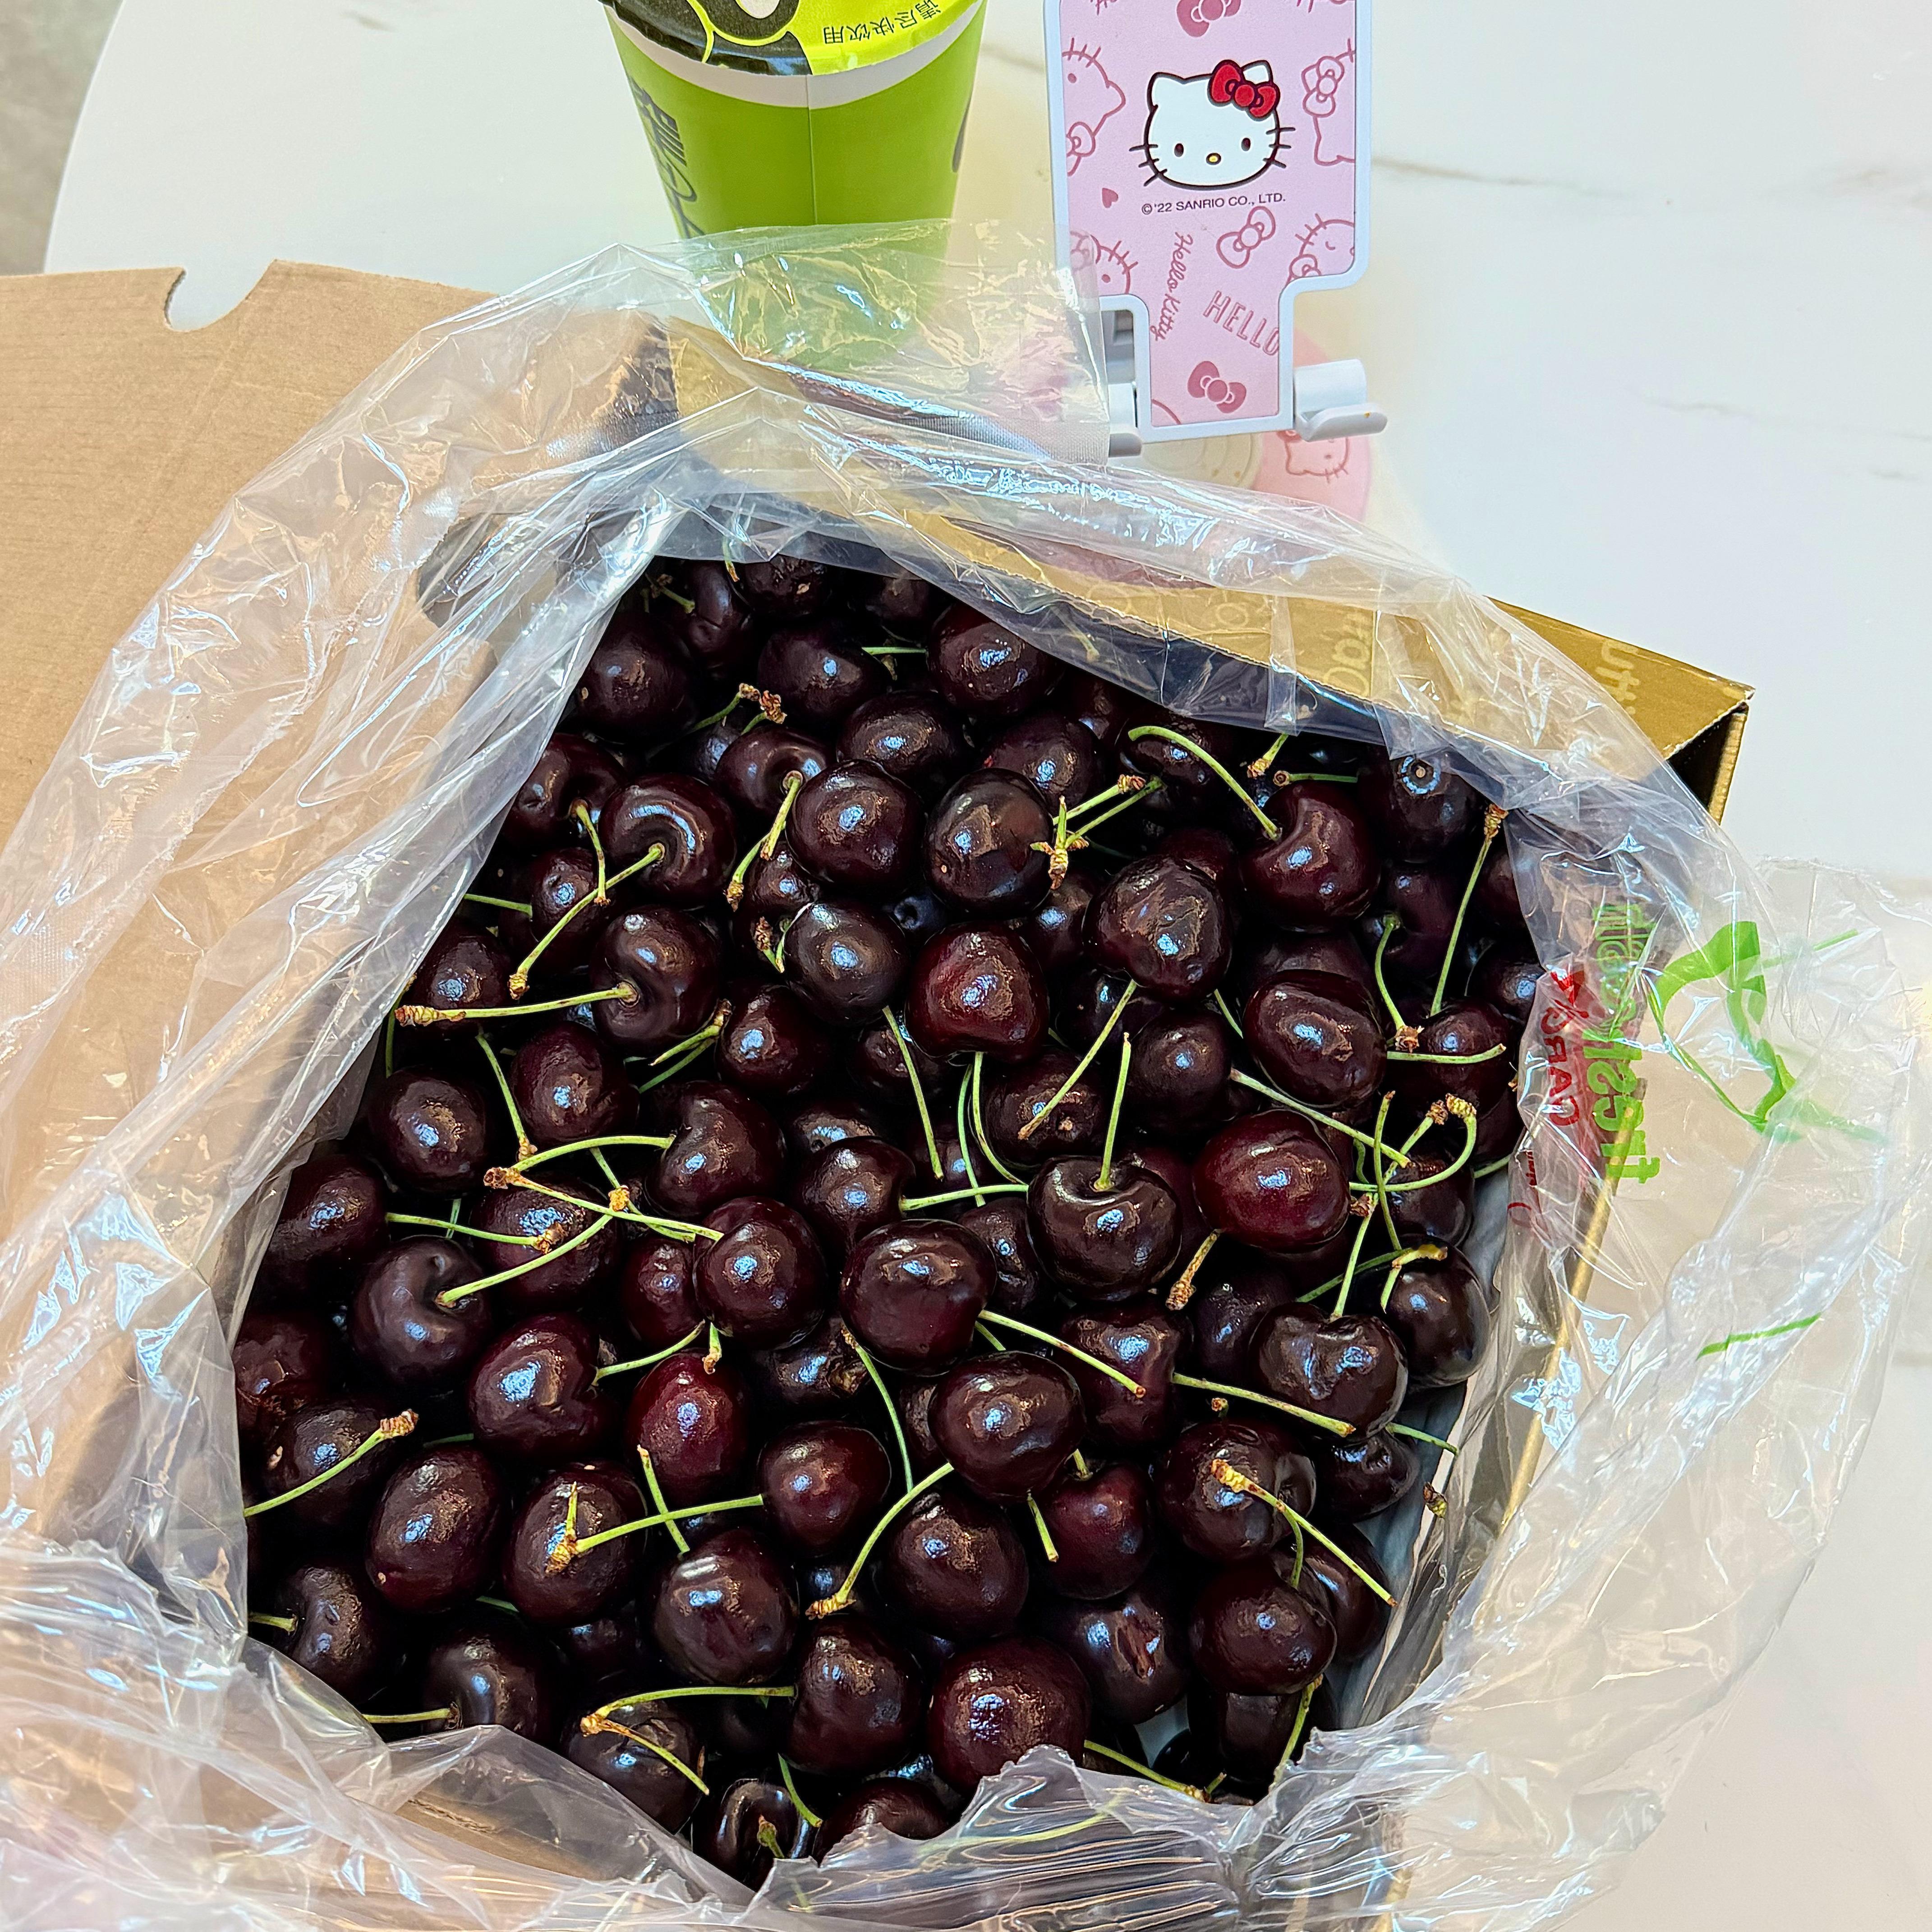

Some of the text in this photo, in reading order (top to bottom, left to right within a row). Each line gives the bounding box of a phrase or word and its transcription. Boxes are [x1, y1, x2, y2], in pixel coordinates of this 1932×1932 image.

[823, 0, 941, 44] 请尽快饮用
[1176, 198, 1225, 211] SANRIO
[1228, 195, 1255, 207] CO.,
[1258, 193, 1286, 204] LTD.
[1150, 231, 1194, 341] Hello Kitty
[1202, 290, 1279, 356] HELLO
